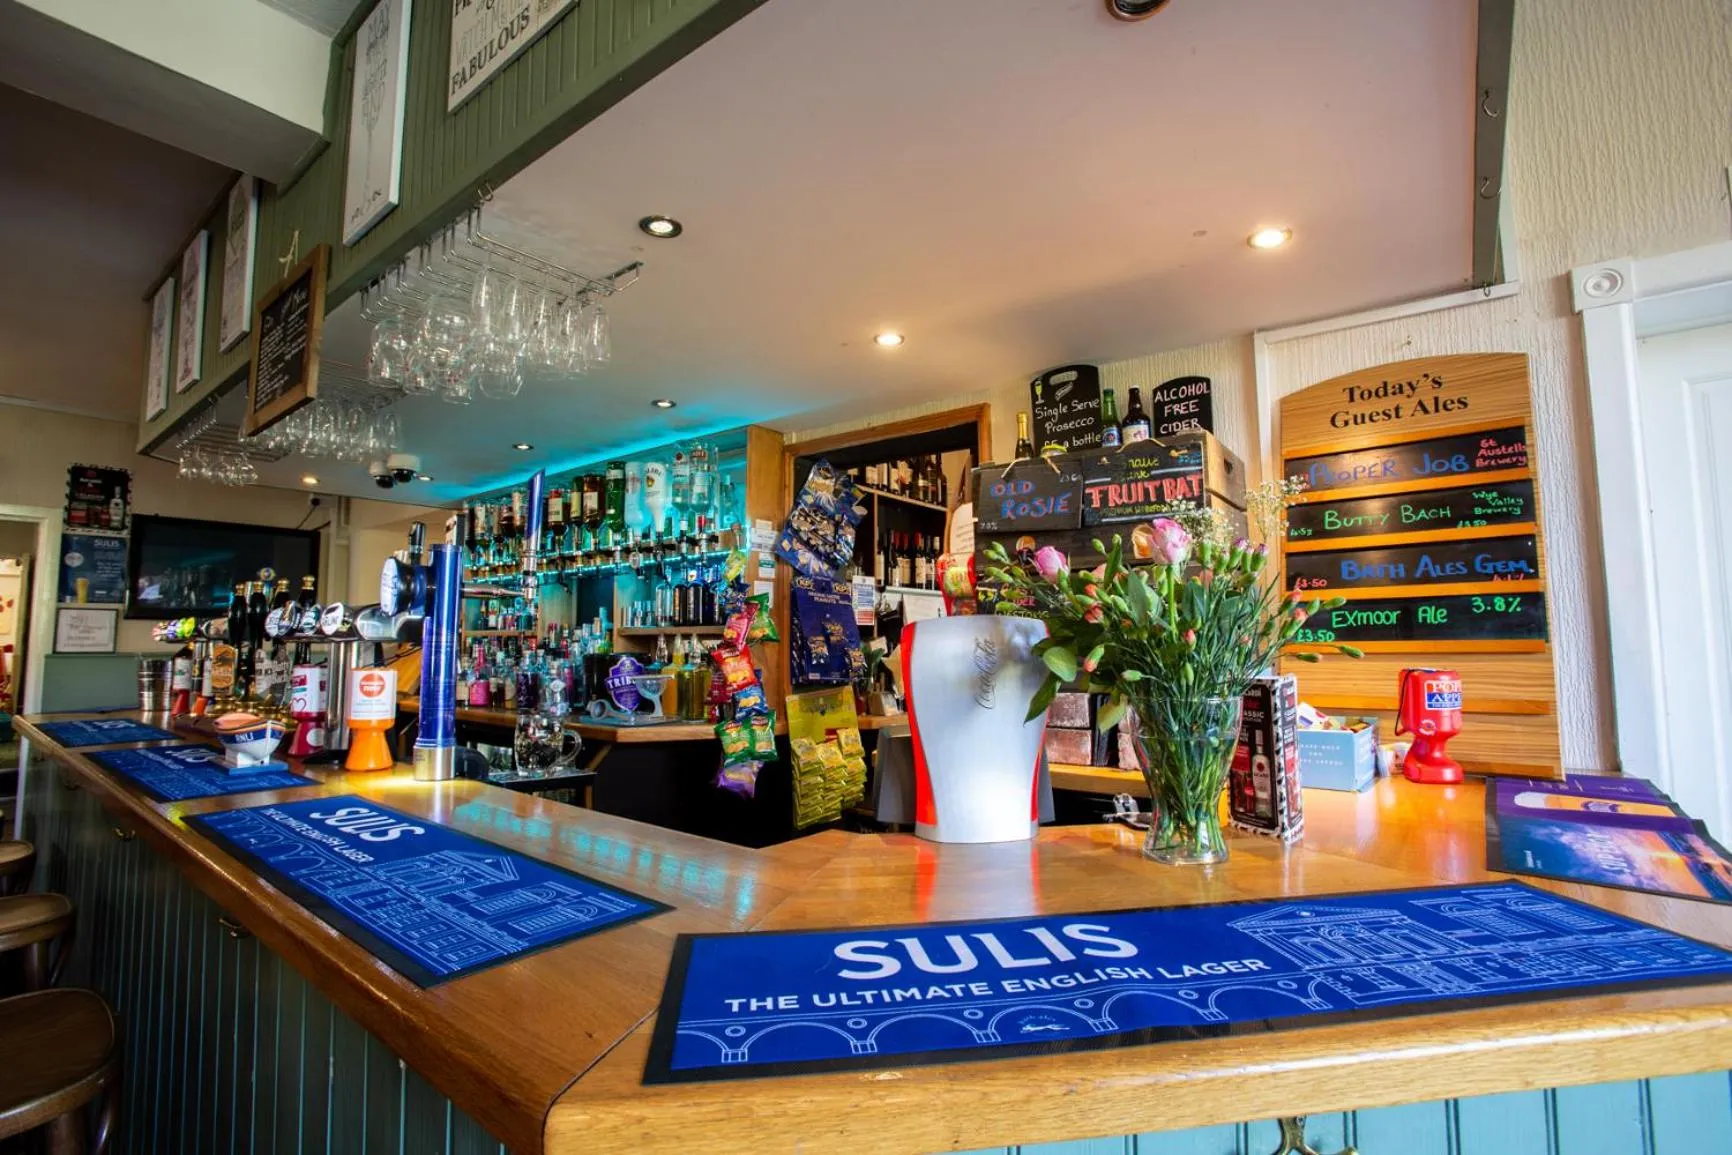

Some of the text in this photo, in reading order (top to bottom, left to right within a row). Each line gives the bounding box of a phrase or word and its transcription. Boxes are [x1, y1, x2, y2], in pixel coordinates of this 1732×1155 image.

[451, 4, 530, 96] FABULOUS
[1154, 381, 1210, 403] ALCOHOL
[1342, 372, 1444, 404] Today's
[1035, 398, 1100, 422] Single Serve
[1164, 400, 1200, 417] FREE
[1330, 395, 1470, 429] Guest Ales
[1044, 417, 1094, 433] Prosecco
[1160, 418, 1200, 433] CIDER
[1072, 433, 1101, 447] bottle
[1413, 452, 1470, 475] JOB
[990, 480, 1035, 498] OLD
[1084, 472, 1202, 508] FRUIT BAT
[1001, 491, 1072, 520] ROSIE
[1340, 559, 1404, 580] BATH
[1415, 554, 1468, 578] ALES
[1417, 605, 1448, 625] Ale
[1472, 597, 1522, 613] 3.8%
[1296, 629, 1336, 642] £3.50
[309, 807, 425, 842] SULIS
[834, 922, 1140, 982] SULIS
[725, 957, 1272, 1013] THE ULTIMATE ENGLISH LAGER
